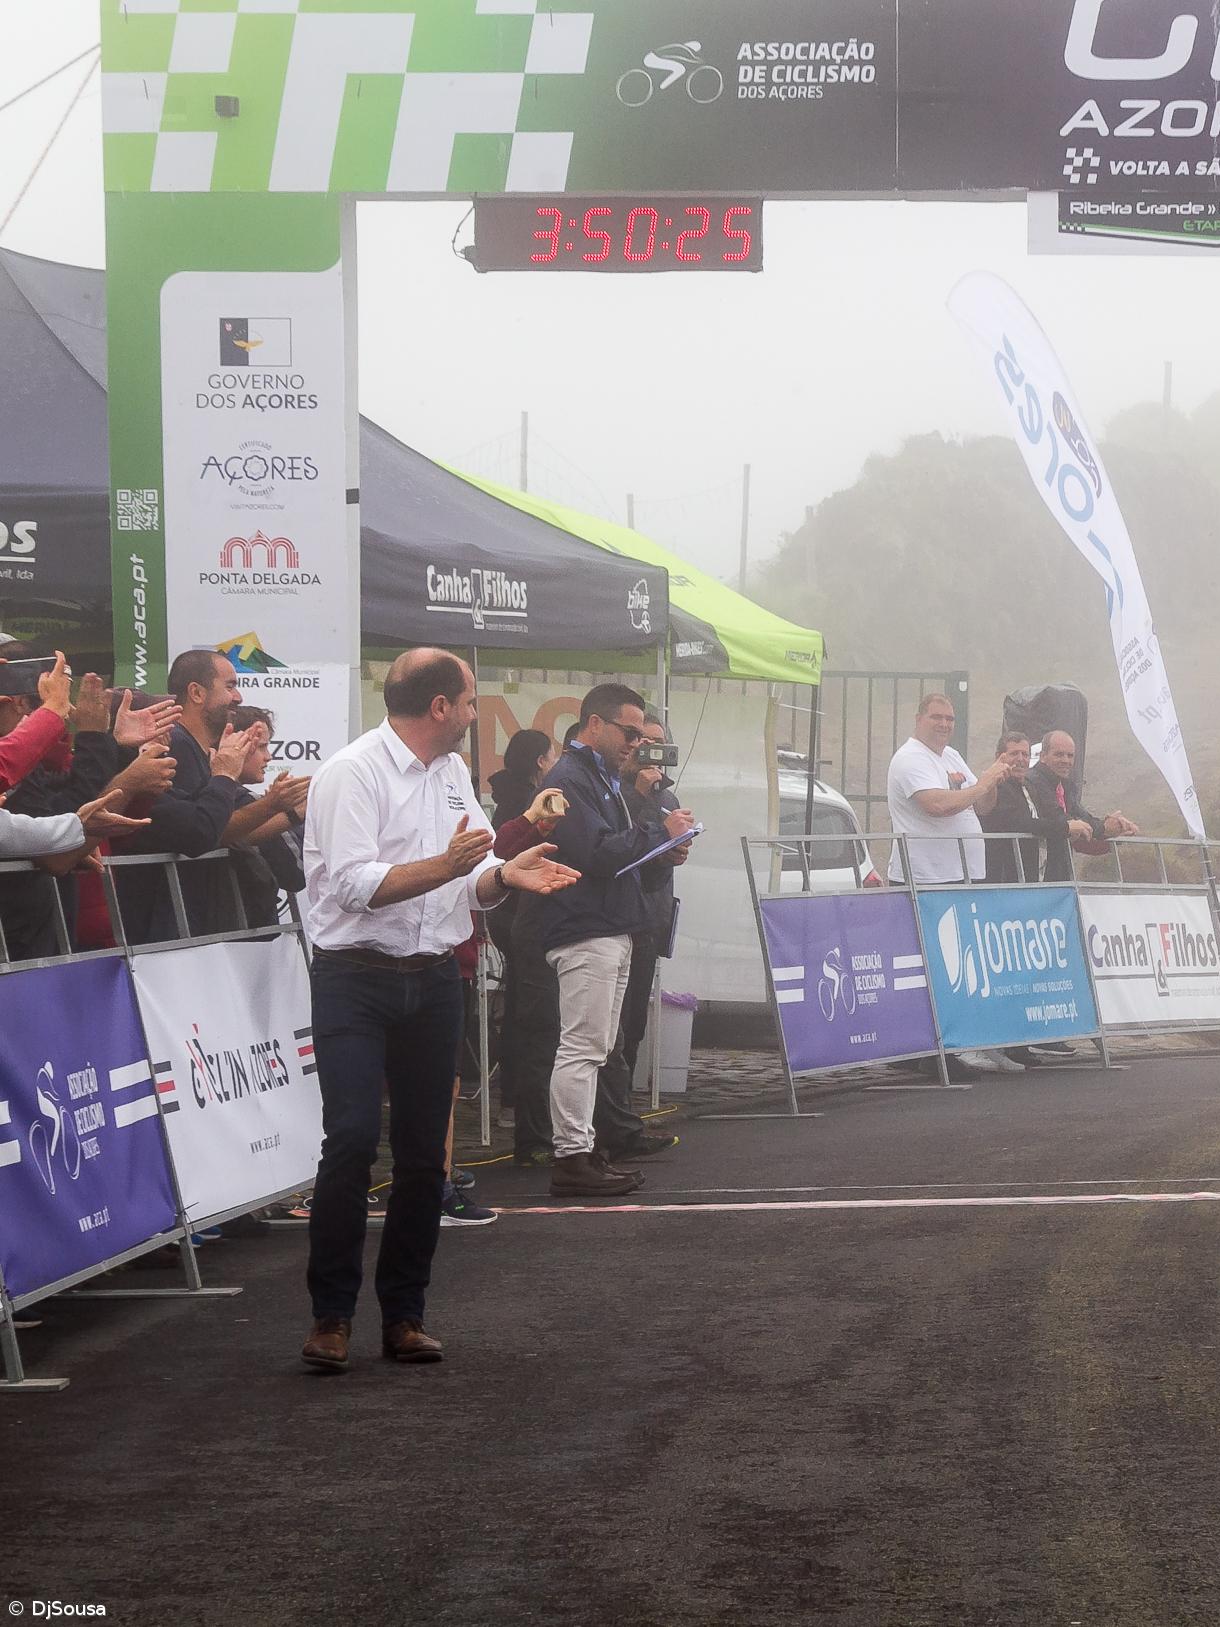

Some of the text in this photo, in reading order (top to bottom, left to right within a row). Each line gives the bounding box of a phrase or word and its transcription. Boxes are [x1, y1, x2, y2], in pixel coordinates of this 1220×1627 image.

[737, 38, 875, 64] ASSOCIAÇÃO
[738, 65, 876, 84] DE CICLISMO
[737, 85, 823, 101] DOS AÇORES
[1109, 160, 1171, 176] VOLTA
[1175, 161, 1190, 175] A
[1069, 201, 1132, 215] Ribeira
[1136, 201, 1204, 215] Grande
[529, 206, 752, 262] 3:50:25
[208, 374, 305, 390] GOVERNO
[196, 393, 318, 412] DOS AÇORES
[200, 455, 319, 486] AÇORES
[199, 573, 321, 585] PONTA DELGADA
[426, 565, 472, 604] Canha
[482, 570, 528, 609] Filhos
[130, 553, 149, 690] ww.aca.pt
[263, 677, 320, 688] GRANDE
[269, 741, 321, 760] ZOR
[970, 902, 1068, 998] jomare
[1088, 923, 1148, 968] Canha
[1158, 922, 1218, 968] Filhos
